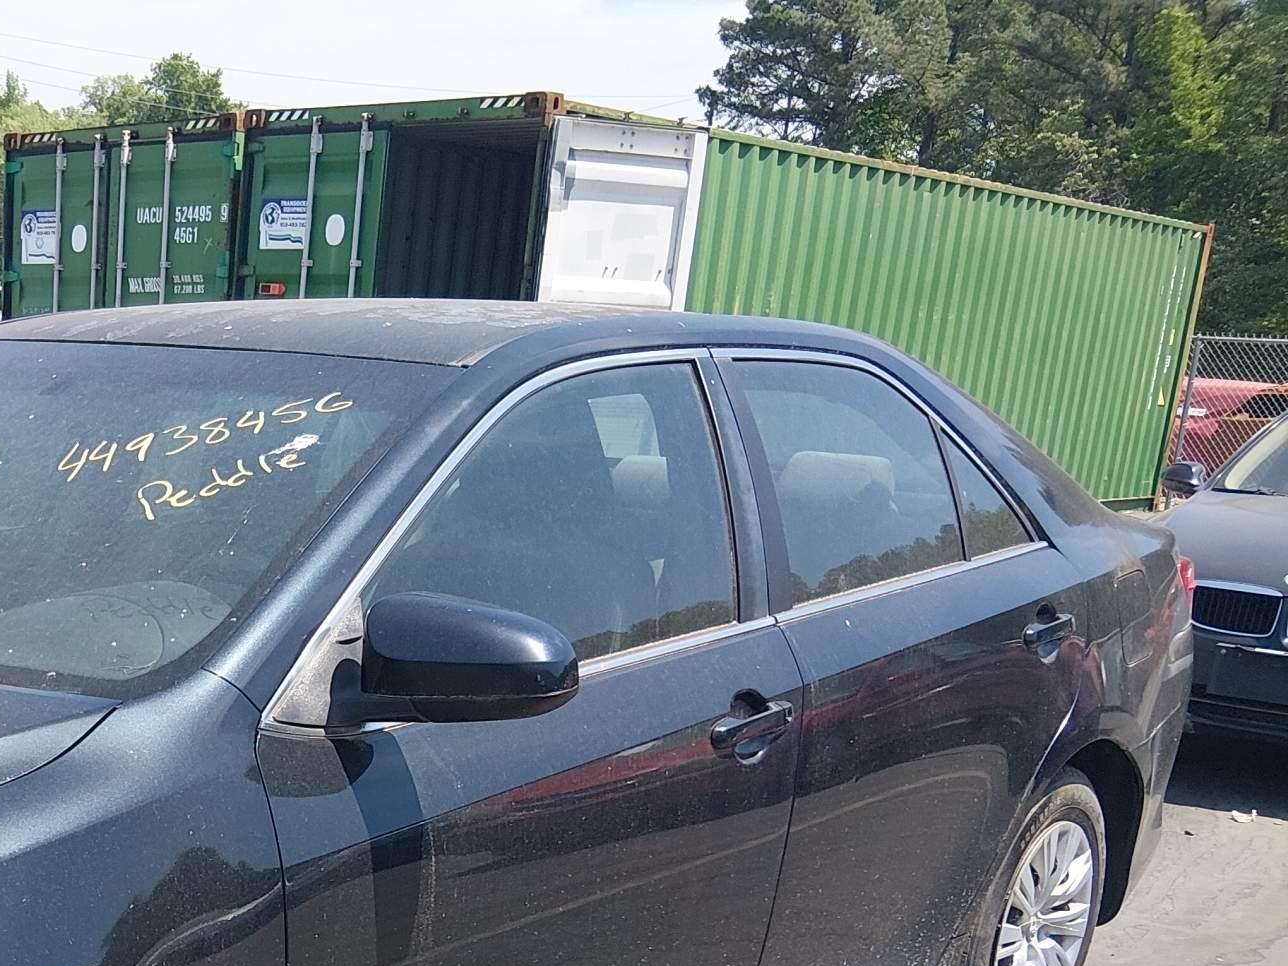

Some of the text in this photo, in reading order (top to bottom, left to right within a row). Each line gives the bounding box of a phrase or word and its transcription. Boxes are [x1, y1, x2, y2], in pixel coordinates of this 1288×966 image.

[136, 203, 230, 224] UACU 524495 9
[174, 226, 198, 244] 45G1
[58, 391, 353, 482] 44938456
